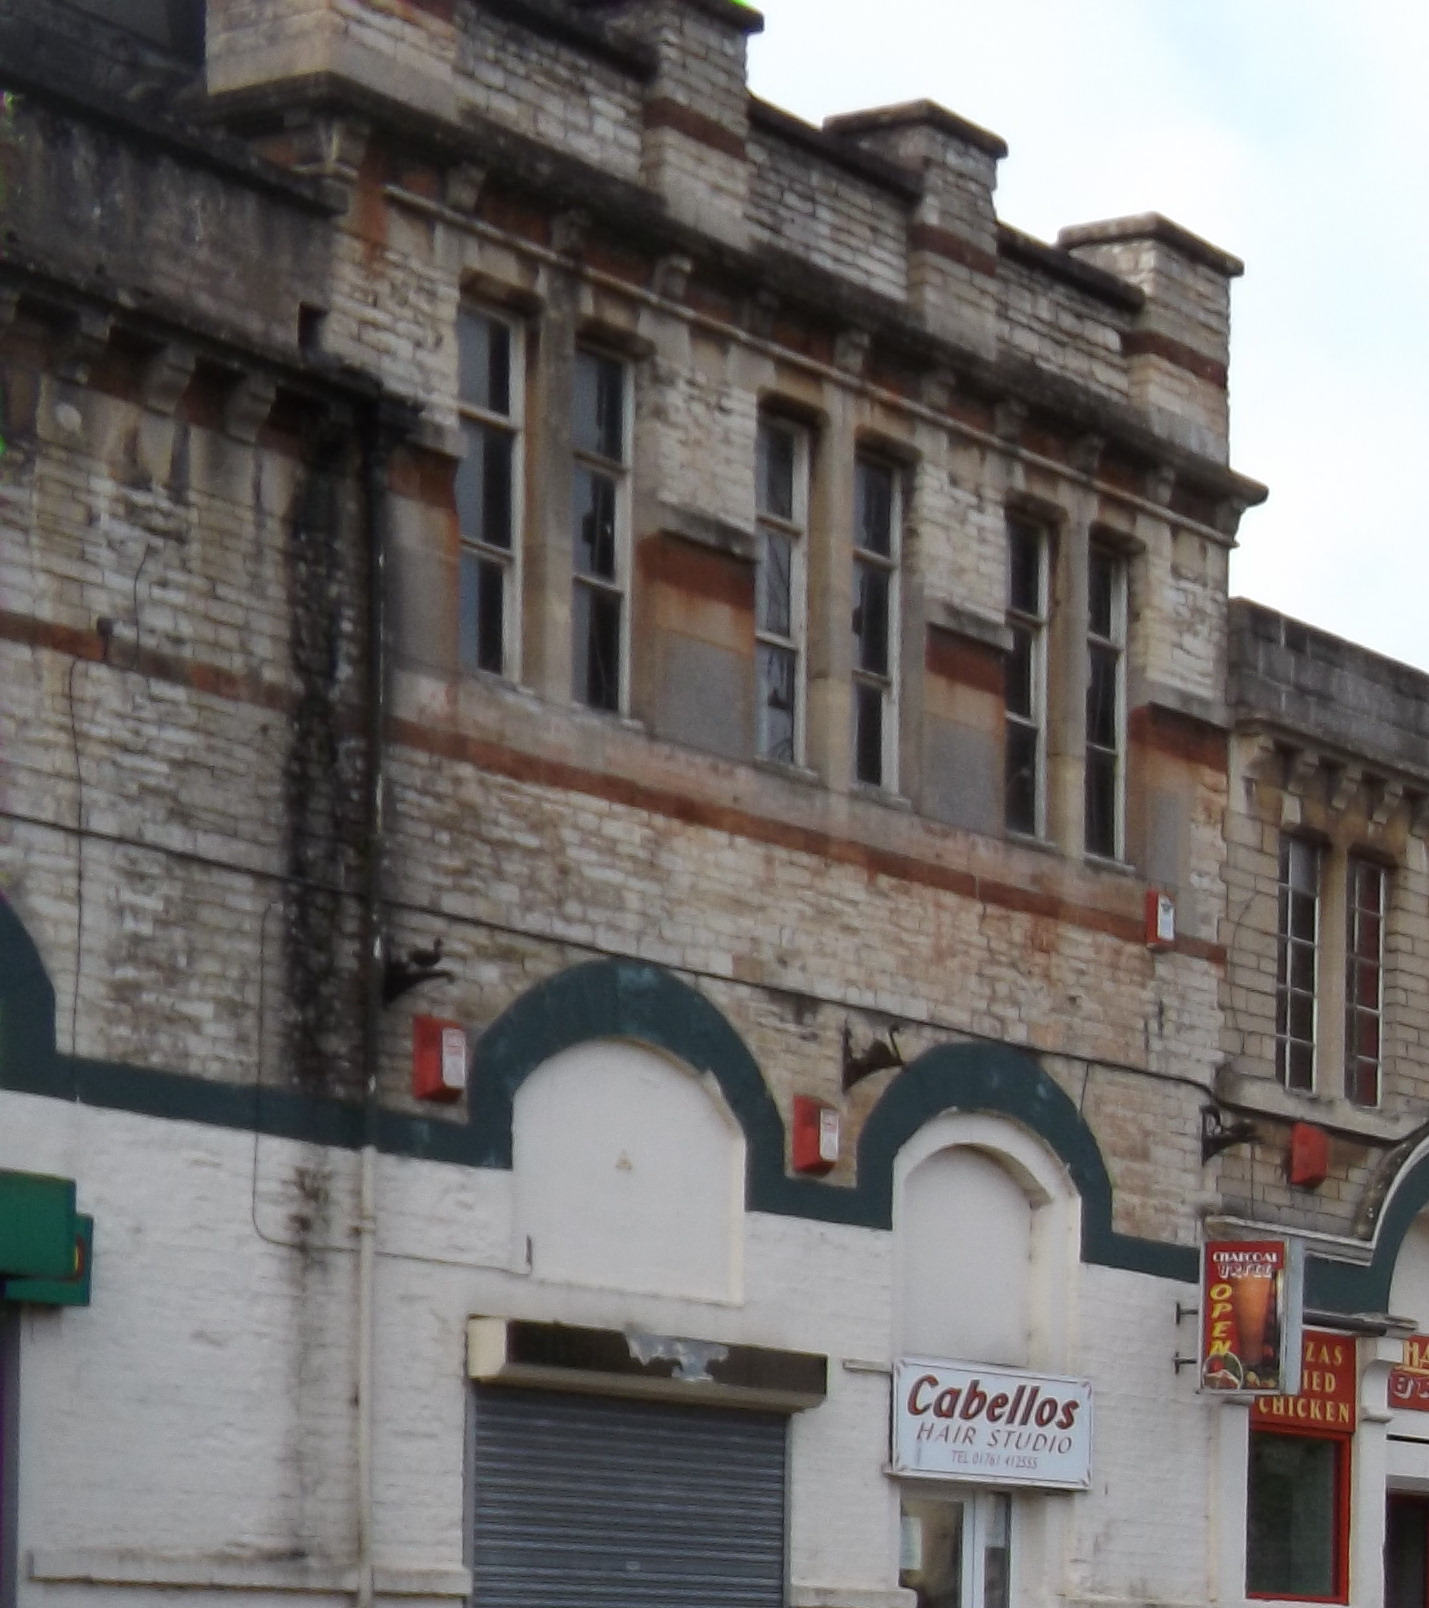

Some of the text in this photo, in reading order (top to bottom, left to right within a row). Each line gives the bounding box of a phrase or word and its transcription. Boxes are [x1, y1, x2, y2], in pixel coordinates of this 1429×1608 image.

[1212, 1251, 1278, 1263] CHARCOAL
[1209, 1283, 1233, 1357] OPEN
[1304, 1341, 1343, 1366] ZAS
[1303, 1368, 1337, 1393] IED
[906, 1373, 1080, 1430] Cabellos
[1258, 1395, 1350, 1423] CHICKEN
[915, 1421, 1073, 1454] HAIR STUDIO
[951, 1450, 969, 1464] TEL
